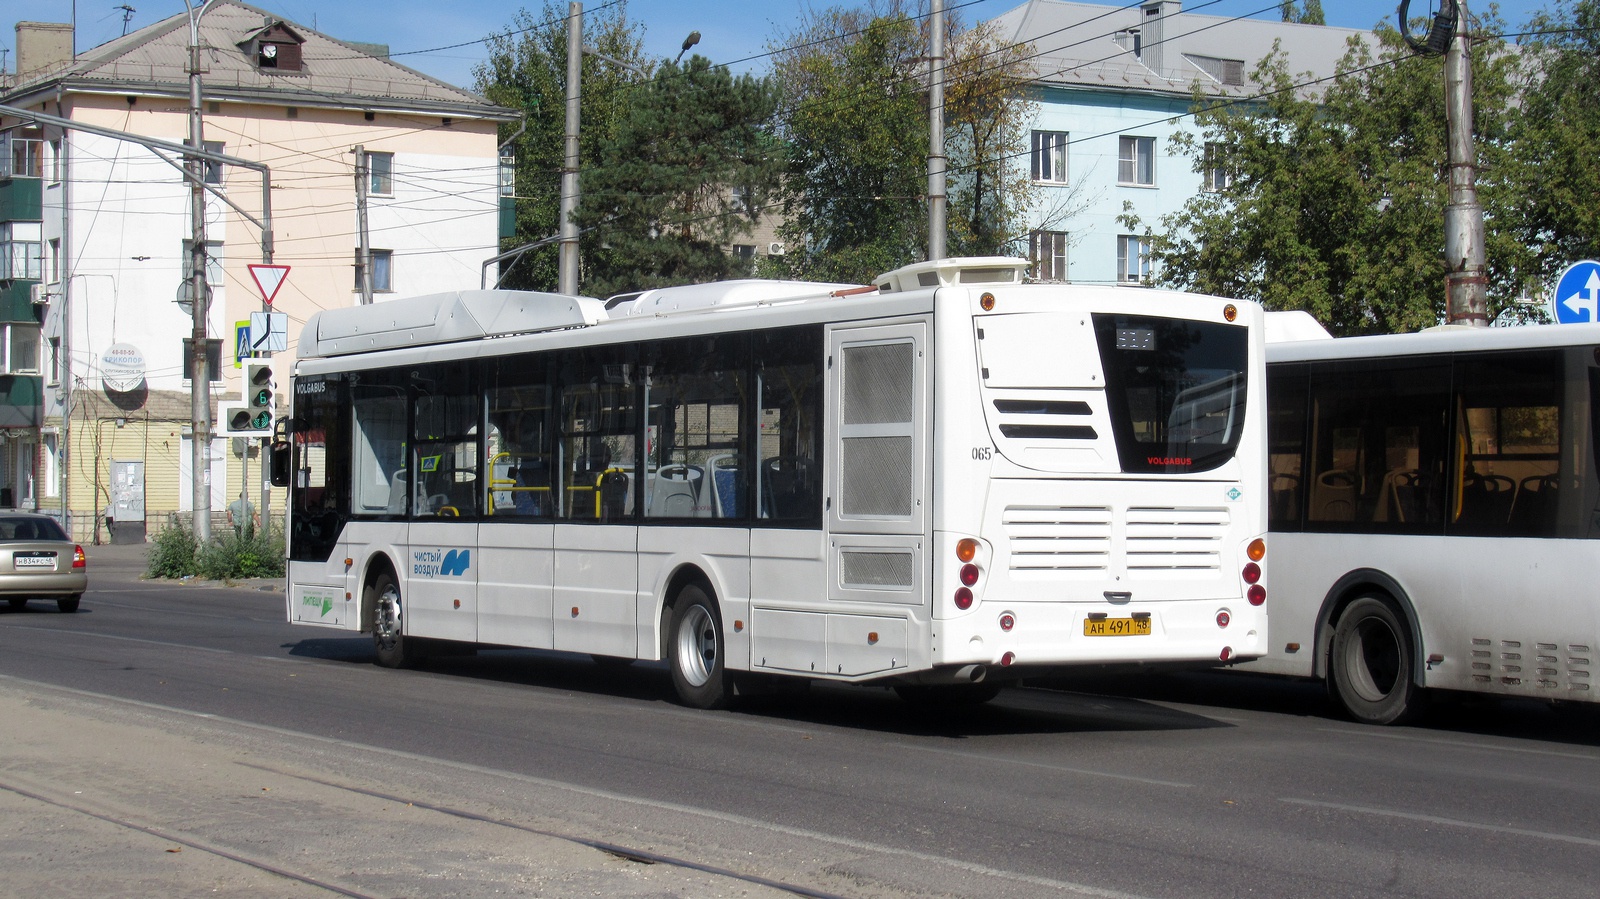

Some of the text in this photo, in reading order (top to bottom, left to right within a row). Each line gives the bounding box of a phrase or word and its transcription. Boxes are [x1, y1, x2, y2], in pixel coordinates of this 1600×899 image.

[296, 382, 326, 394] VOLGABUS
[259, 392, 267, 405] 6
[971, 447, 992, 461] 065
[1147, 457, 1192, 466] VOLGABUS
[1090, 620, 1148, 634] АН 491 48
